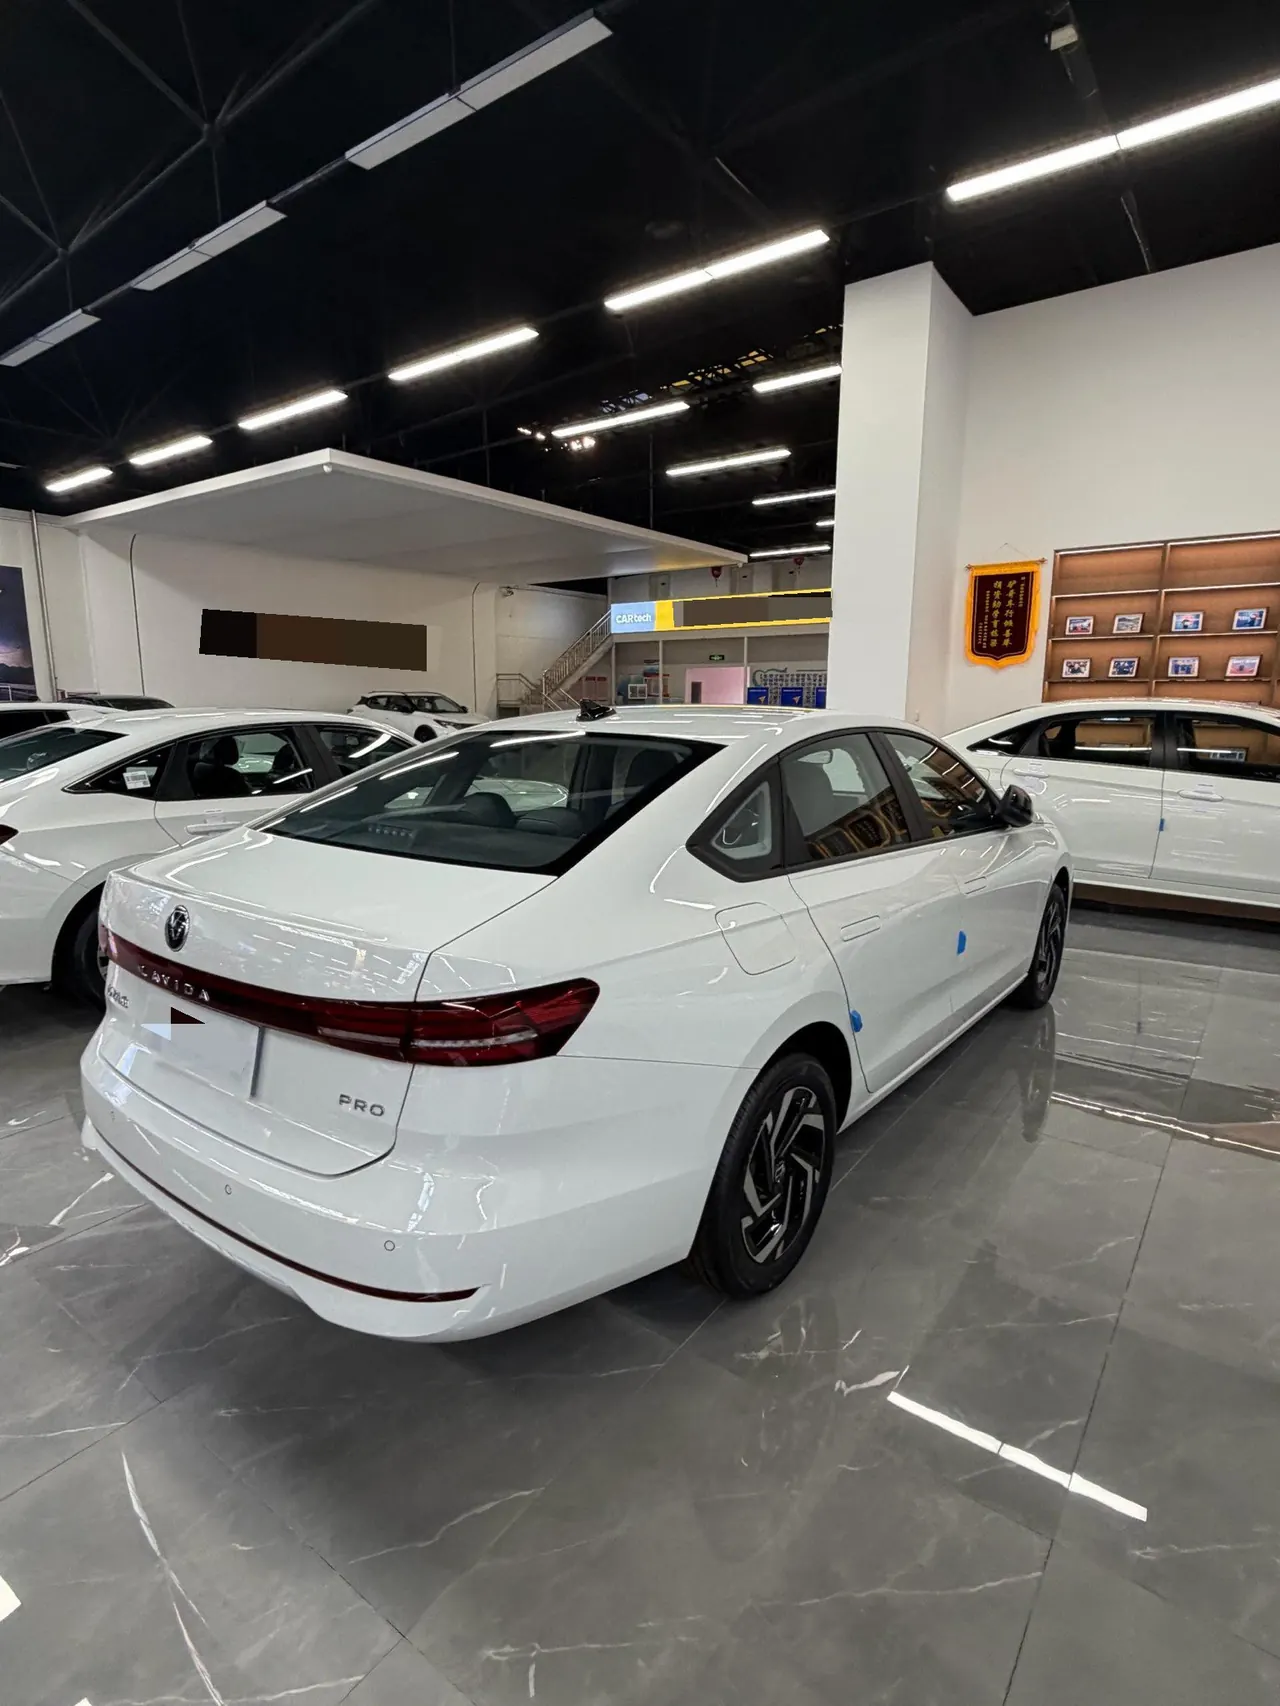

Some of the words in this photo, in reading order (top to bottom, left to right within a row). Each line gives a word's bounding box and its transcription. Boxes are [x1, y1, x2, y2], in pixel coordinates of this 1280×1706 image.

[615, 613, 652, 624] CARtech
[138, 965, 210, 1002] LAVIDA
[339, 1093, 385, 1117] PRO
